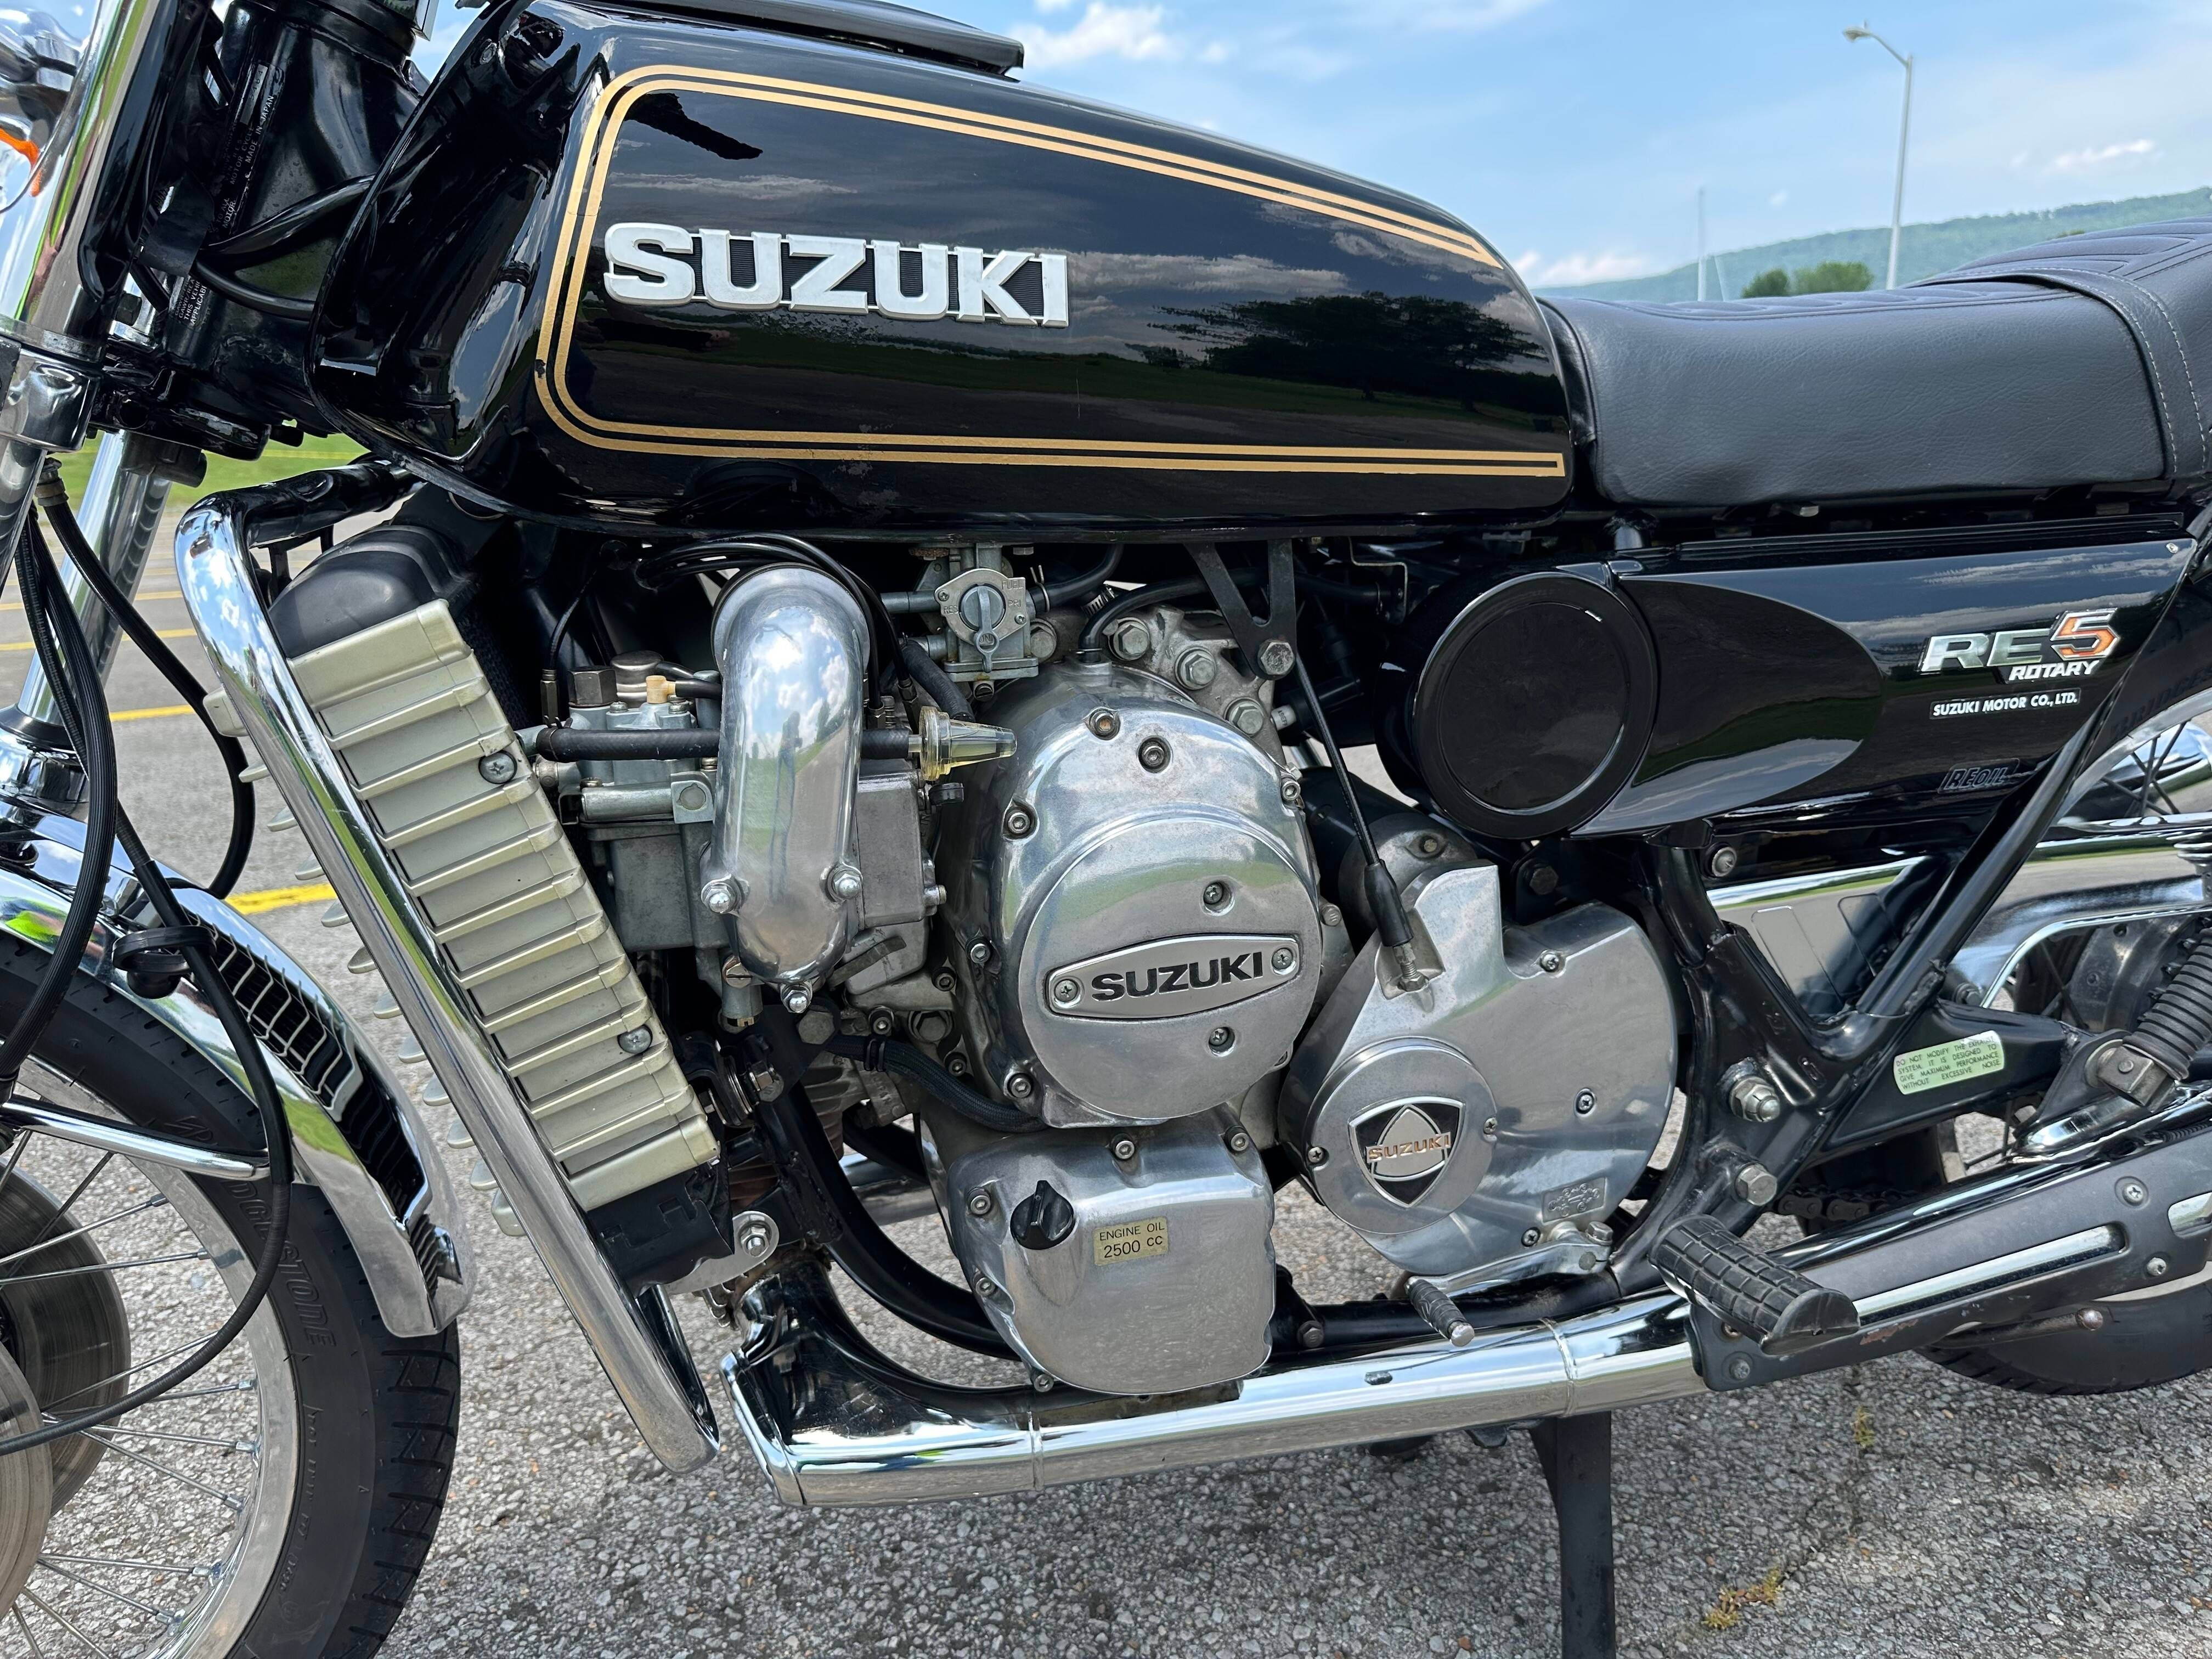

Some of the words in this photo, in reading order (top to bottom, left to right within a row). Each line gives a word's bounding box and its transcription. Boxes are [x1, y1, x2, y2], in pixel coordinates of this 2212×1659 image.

[245, 140, 258, 163] MADE
[255, 126, 263, 135] IN
[259, 95, 274, 122] JAPAN
[229, 155, 244, 184] MOTOR
[604, 222, 1068, 328] SUZUKI
[179, 278, 195, 319] GAWR/REA
[183, 303, 194, 320] THIS
[1002, 580, 1024, 590] FUEL
[944, 605, 958, 614] RES
[1008, 599, 1022, 608] PRI
[1920, 608, 2120, 673] RE5
[2008, 660, 2099, 682] ROTARY
[1933, 701, 1979, 717] SUZUKI
[1982, 696, 2026, 713] MOTOR
[1092, 952, 1263, 1001] SUZUKI
[1910, 1054, 1922, 1063] NOT
[1927, 1048, 1949, 1058] MODIFY
[1953, 1048, 1981, 1060] DESIGNED
[1900, 1074, 1914, 1082] GIVE
[1920, 1065, 1950, 1077] MAXIMUM
[1956, 1052, 1999, 1067] PERFORMANCE
[1901, 1078, 1929, 1089] WITHOUT
[1941, 1067, 1972, 1080] EXCESSIVE
[1982, 1059, 2001, 1069] NOISE
[1368, 1135, 1451, 1161] SUZUKI
[1099, 1225, 1141, 1242] ENGINE
[1147, 1223, 1165, 1233] OIL
[1104, 1240, 1141, 1259] 2500
